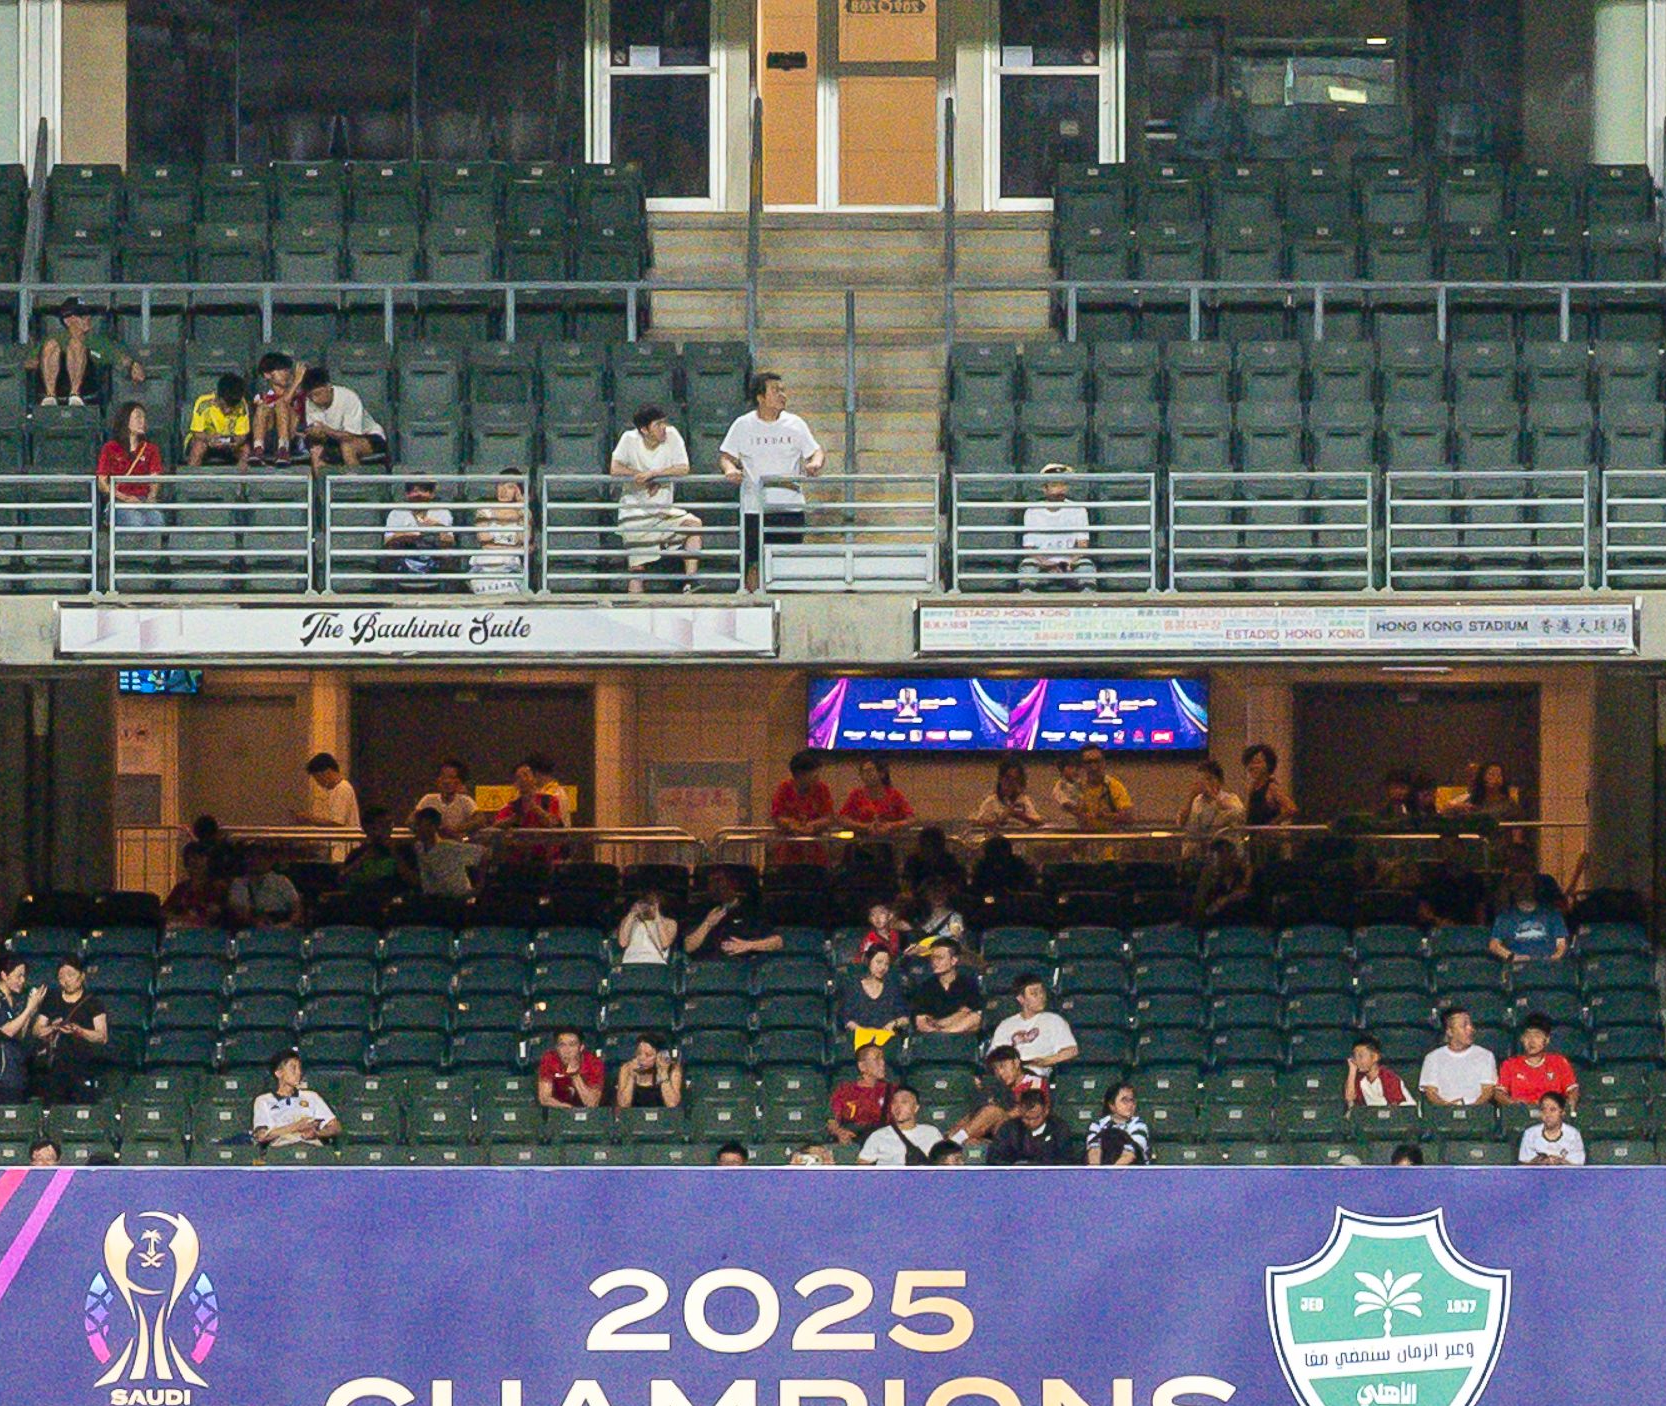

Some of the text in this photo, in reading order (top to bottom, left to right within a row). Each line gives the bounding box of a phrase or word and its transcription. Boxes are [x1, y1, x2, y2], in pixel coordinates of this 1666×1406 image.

[954, 609, 1071, 618] ESTADIO HONG KONG
[300, 611, 531, 647] The Bauhinia Suite
[1376, 620, 1528, 632] HONG KONG STADIUM
[1225, 629, 1365, 640] ESTADIO HONG KONG
[586, 1267, 976, 1354] 2025
[1300, 1297, 1324, 1312] JED
[110, 1388, 191, 1406] SAUDI
